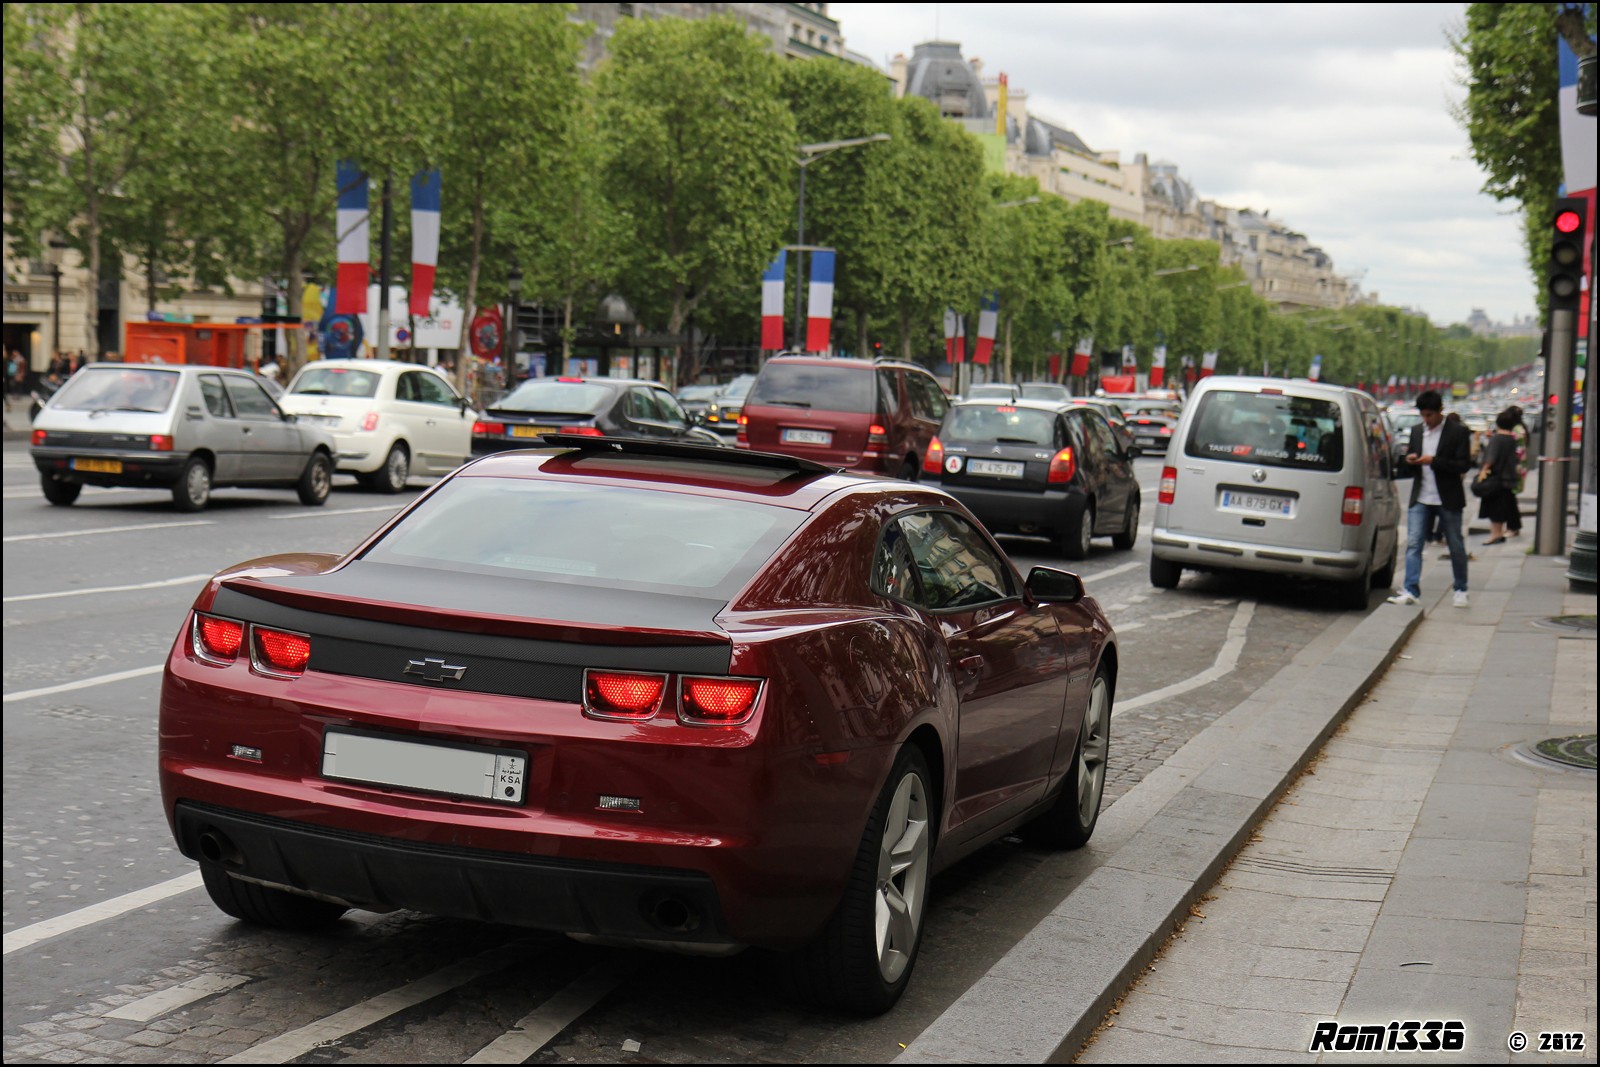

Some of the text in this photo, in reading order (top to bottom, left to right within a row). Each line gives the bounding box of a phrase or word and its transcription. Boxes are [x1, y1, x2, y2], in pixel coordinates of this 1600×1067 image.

[1208, 443, 1232, 453] TAXIS
[1254, 447, 1289, 459] MaxiCab
[1294, 451, 1320, 462] 3607
[950, 458, 958, 470] A
[501, 775, 520, 784] KSA
